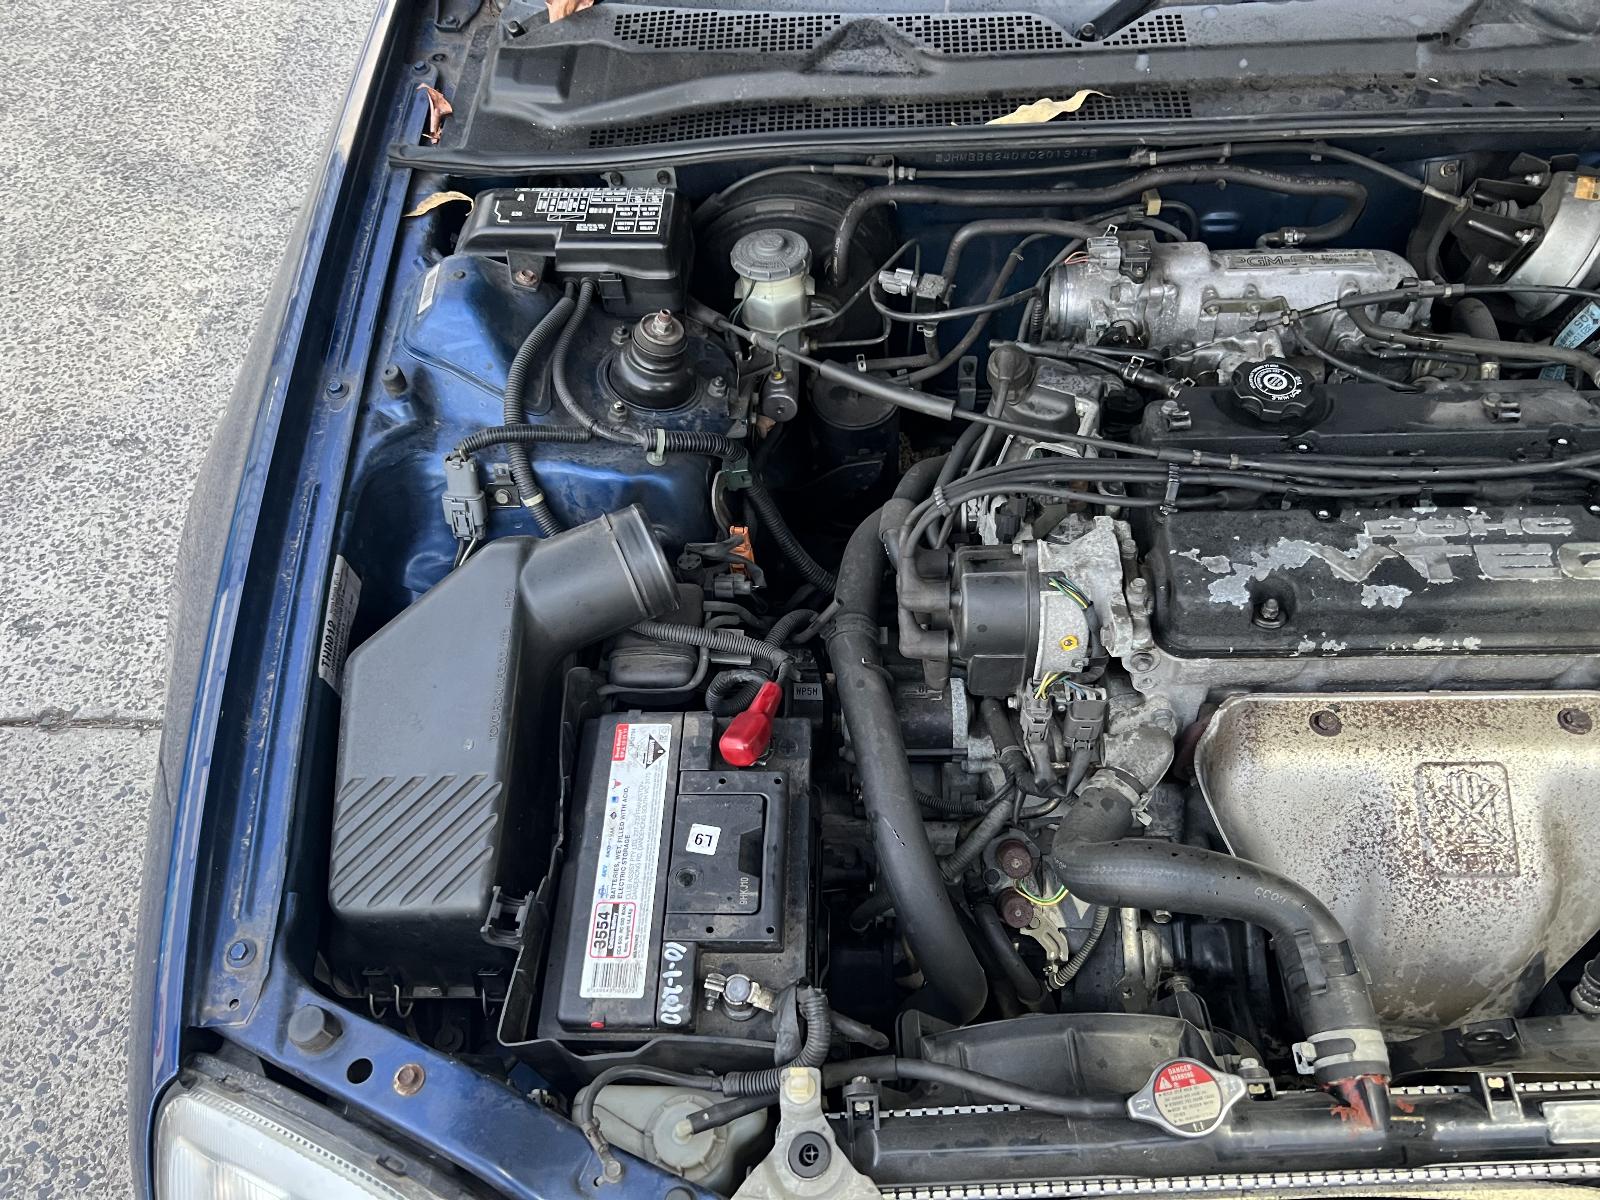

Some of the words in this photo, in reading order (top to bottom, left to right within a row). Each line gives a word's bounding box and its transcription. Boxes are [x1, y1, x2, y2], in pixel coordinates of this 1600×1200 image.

[619, 804, 627, 818] WITH
[616, 821, 624, 842] FILLED
[694, 833, 713, 848] 67
[616, 866, 626, 898] ELECTRIC
[621, 834, 630, 864] STORAGE
[609, 861, 620, 898] BATTERIES,
[593, 911, 610, 949] 3554
[1168, 1064, 1193, 1075] DANGER
